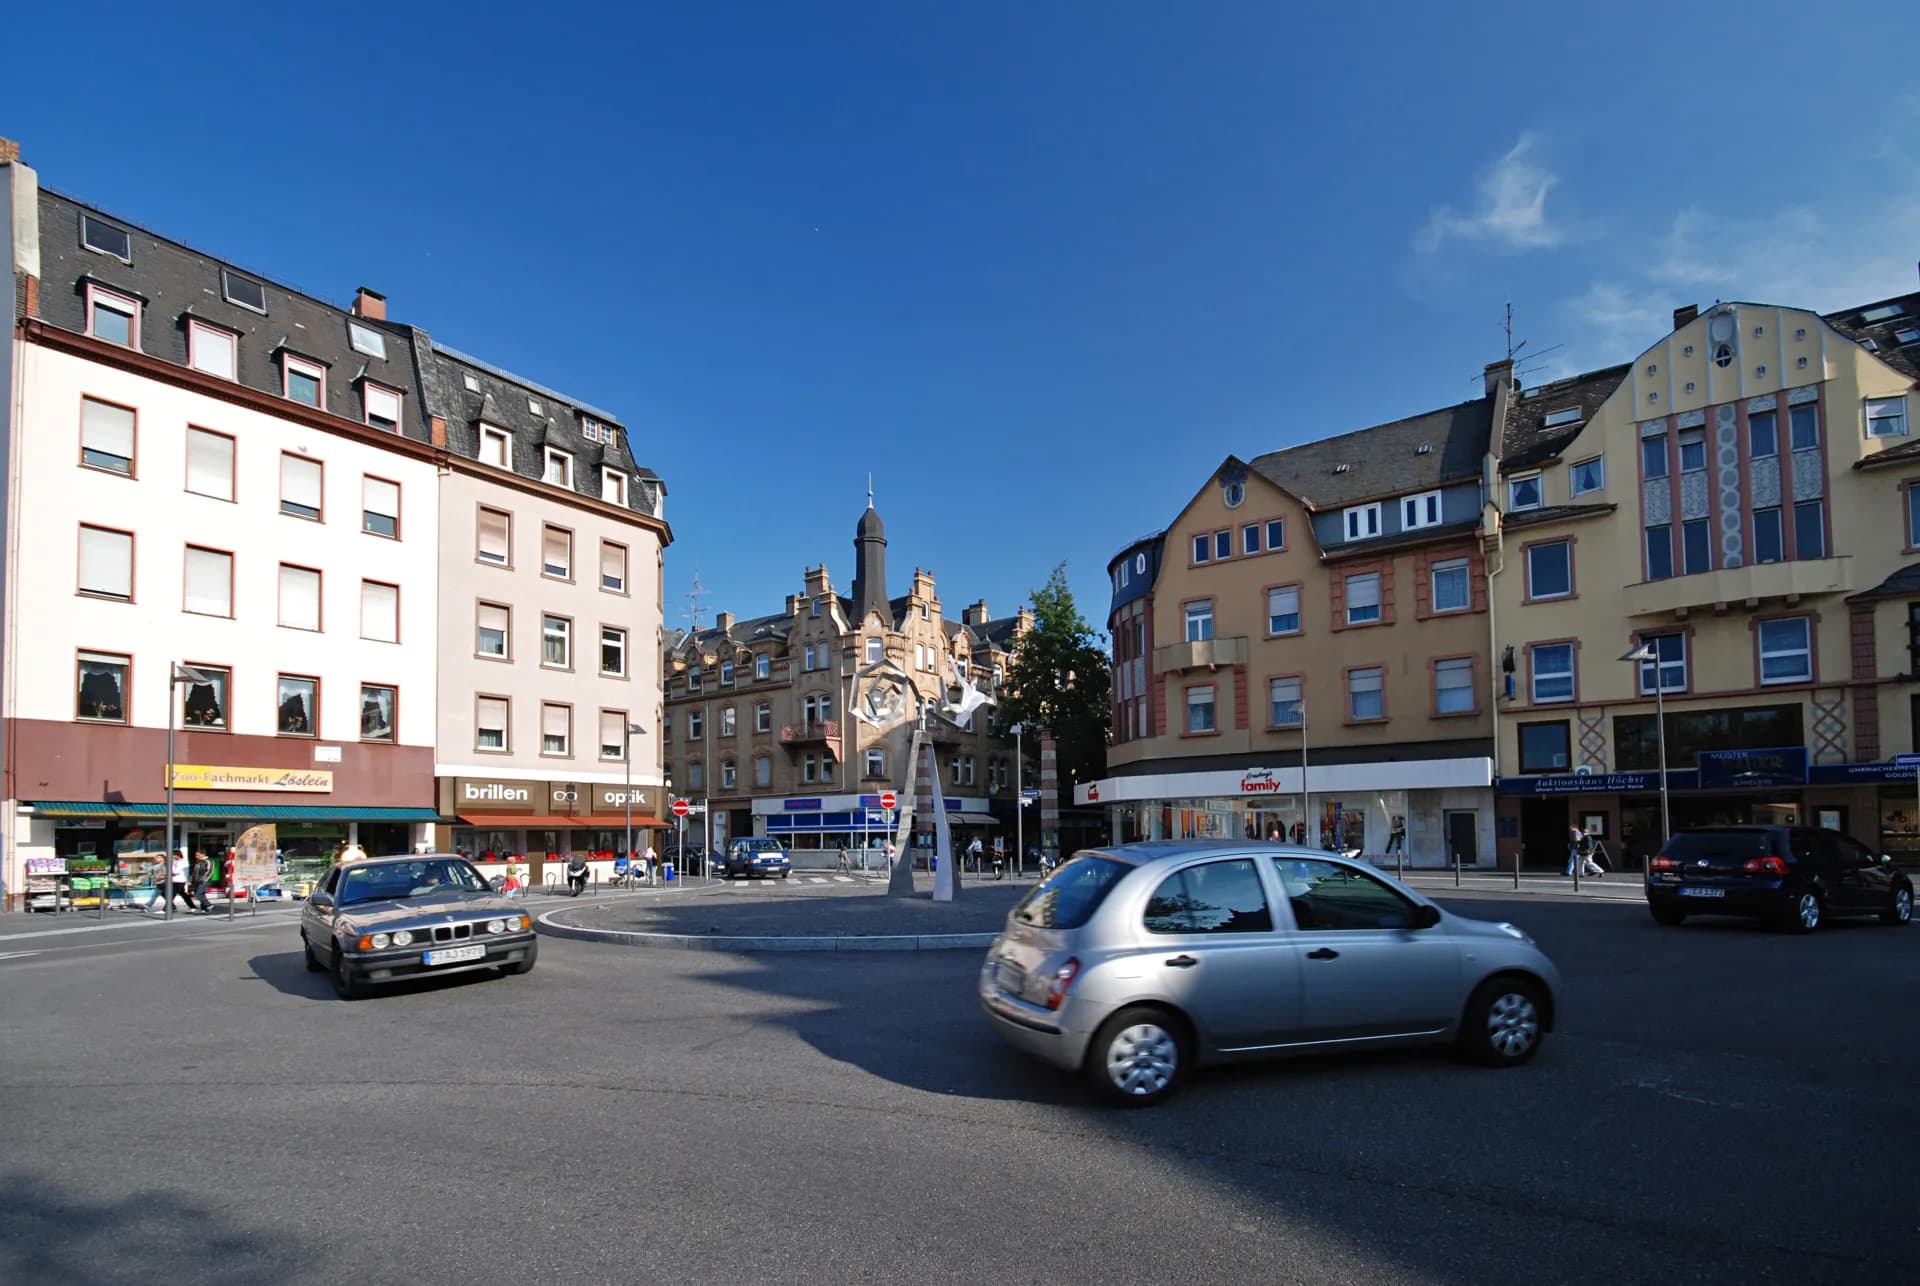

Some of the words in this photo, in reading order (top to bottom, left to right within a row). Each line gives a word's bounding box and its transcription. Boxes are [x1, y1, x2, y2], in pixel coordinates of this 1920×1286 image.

[1711, 752, 1748, 760] MEISTER
[273, 772, 329, 786] Löslein
[1241, 778, 1281, 793] family
[1536, 775, 1603, 787] Auktionshaus
[1607, 775, 1645, 785] Höchst
[465, 783, 528, 801] brillen
